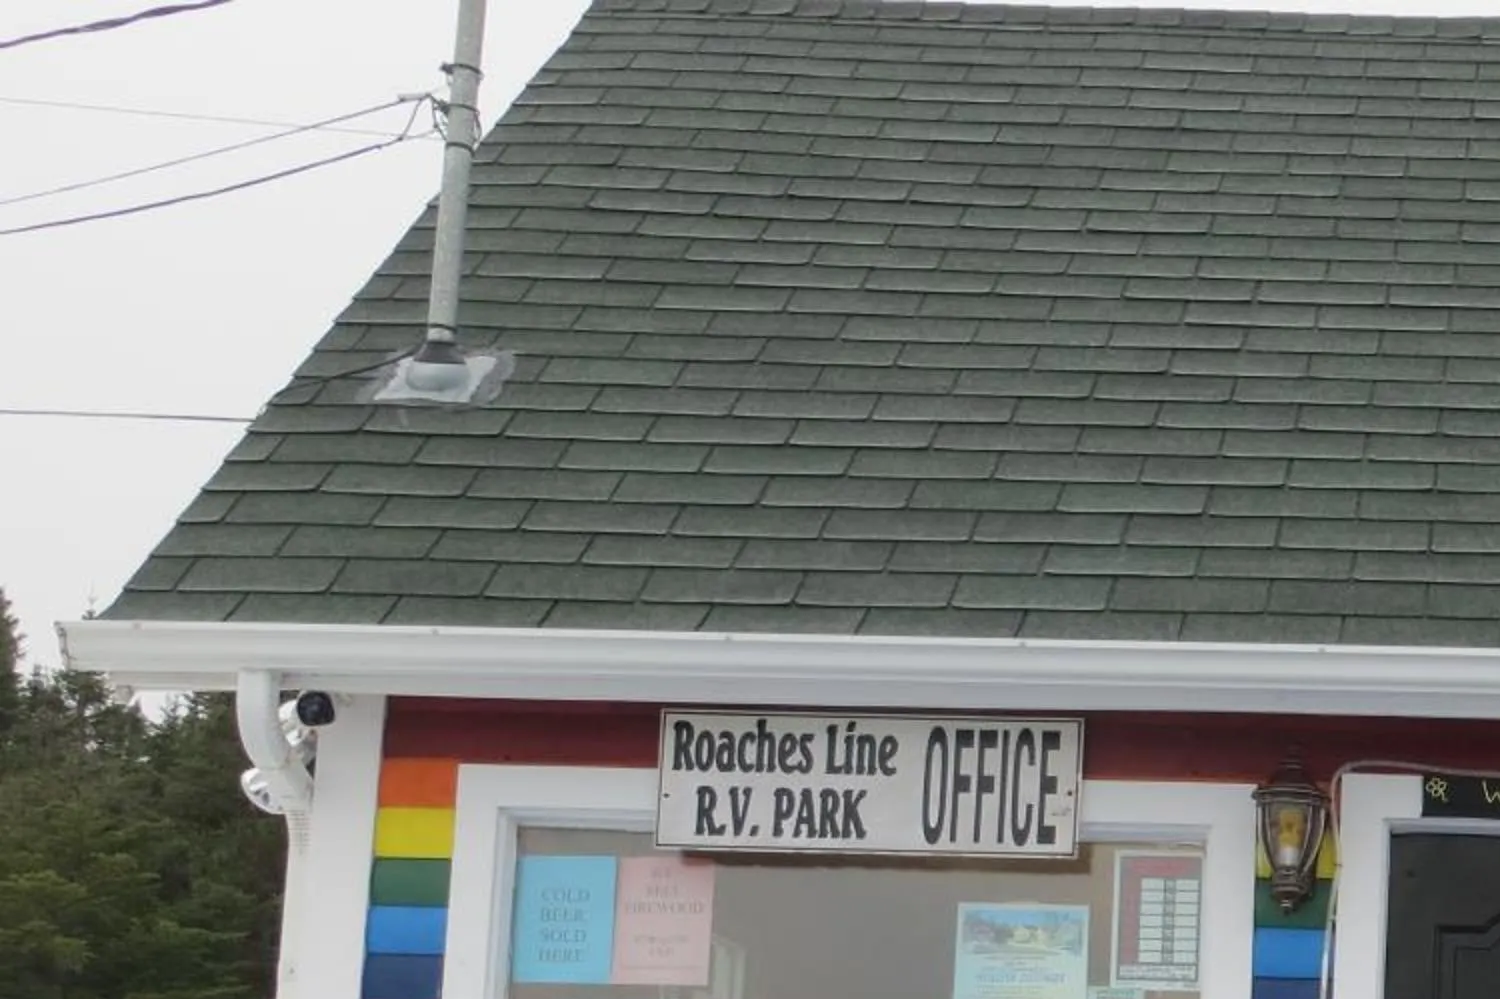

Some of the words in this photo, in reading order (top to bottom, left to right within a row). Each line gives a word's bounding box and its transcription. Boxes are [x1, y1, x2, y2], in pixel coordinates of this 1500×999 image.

[672, 718, 815, 775] Roaches
[824, 721, 899, 777] Line
[921, 726, 1062, 847] OFFICE
[694, 785, 760, 839] R.V.
[771, 787, 868, 840] PARK
[541, 886, 591, 903] COLD
[539, 906, 587, 923] BEER
[540, 928, 587, 944] SOLD
[538, 948, 586, 963] HERE
